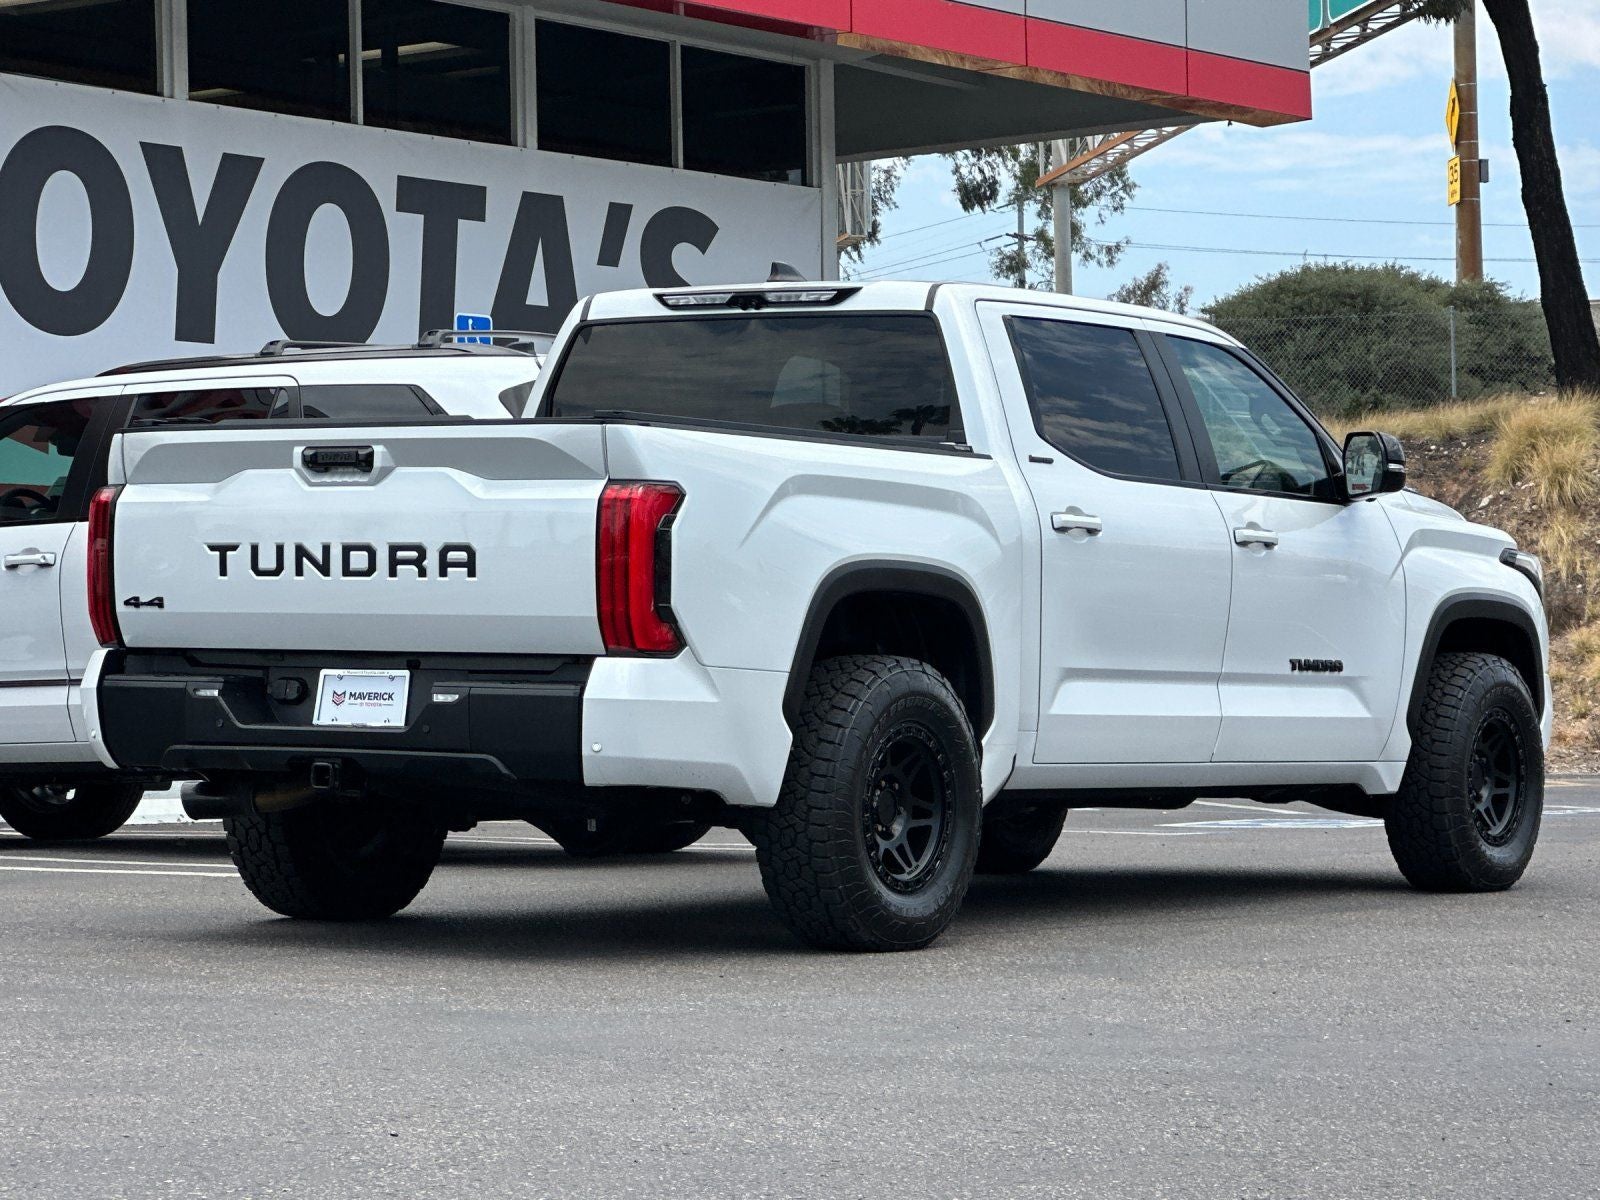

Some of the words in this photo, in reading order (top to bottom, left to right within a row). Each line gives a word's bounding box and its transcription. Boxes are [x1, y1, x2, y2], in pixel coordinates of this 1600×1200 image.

[1450, 163, 1458, 184] 35
[205, 542, 477, 578] TUNDRA
[1289, 659, 1343, 672] TUNDRA
[348, 691, 395, 701] MAVERICK
